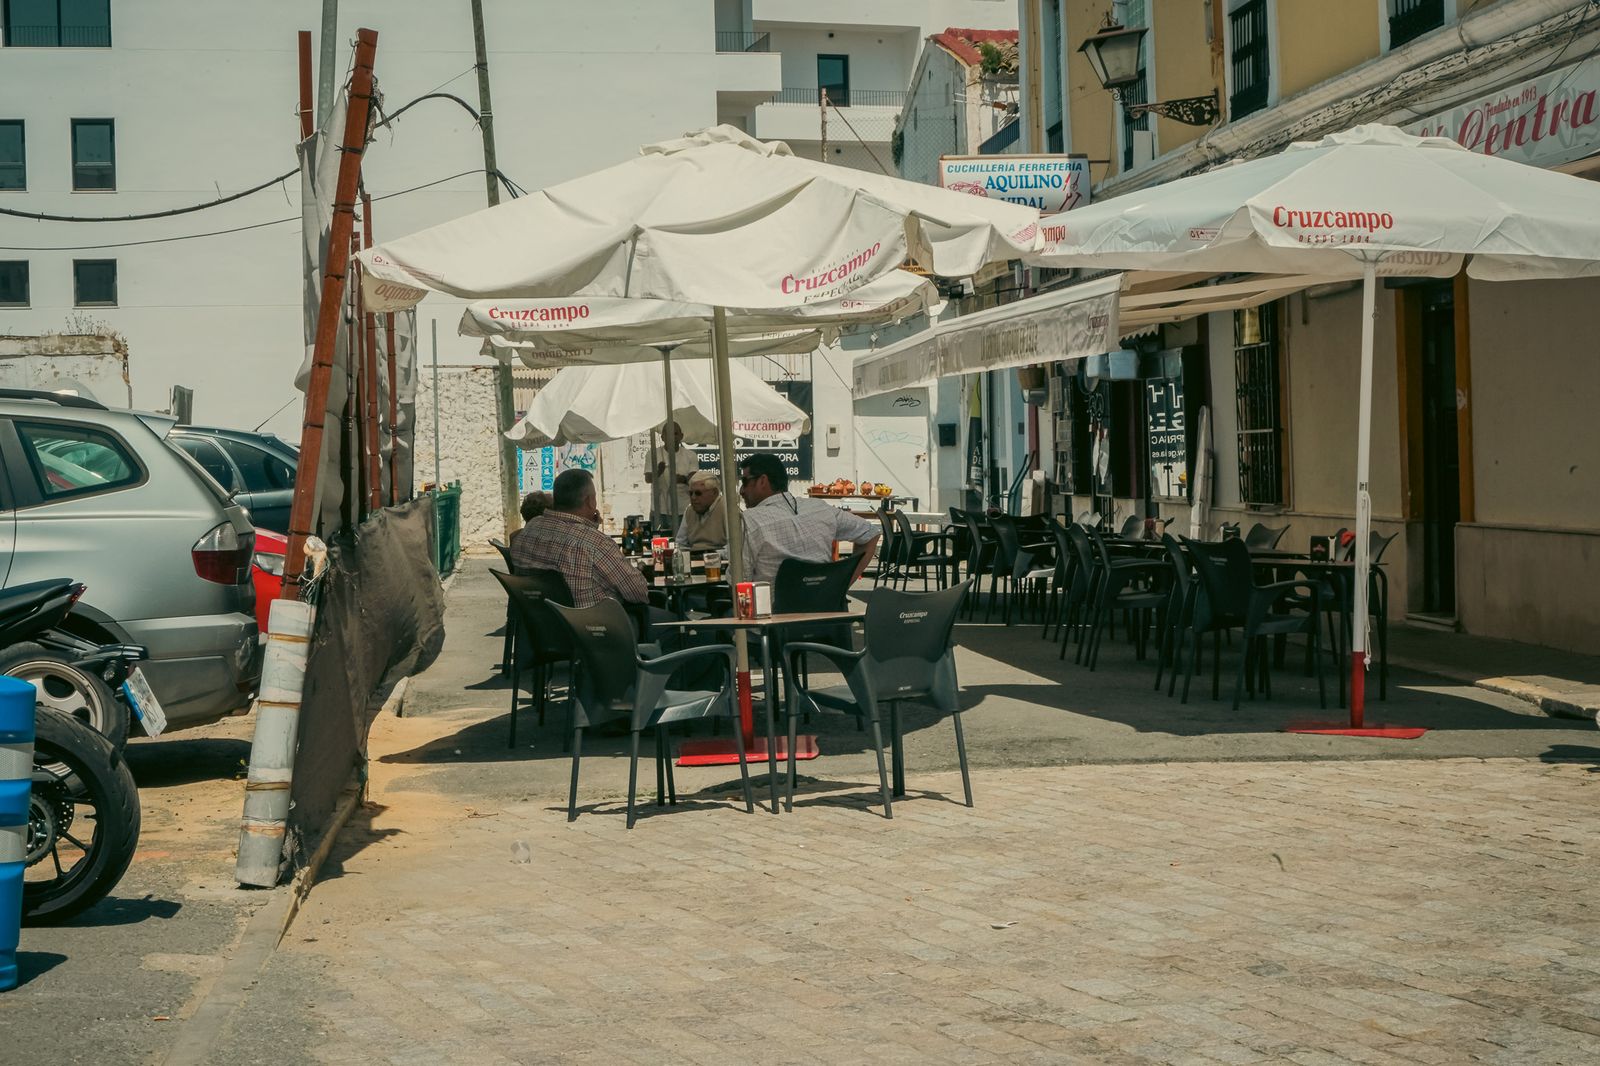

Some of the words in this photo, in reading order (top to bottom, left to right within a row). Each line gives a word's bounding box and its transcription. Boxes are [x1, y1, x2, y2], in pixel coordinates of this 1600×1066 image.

[1521, 86, 1537, 104] 1913
[985, 174, 1063, 192] AQUILINO
[1272, 206, 1394, 233] Cruzcampo
[781, 242, 881, 294] Cruzcampo
[488, 304, 590, 322] Cruzcampo
[732, 420, 792, 433] Cruzcampo
[697, 453, 720, 462] RESA
